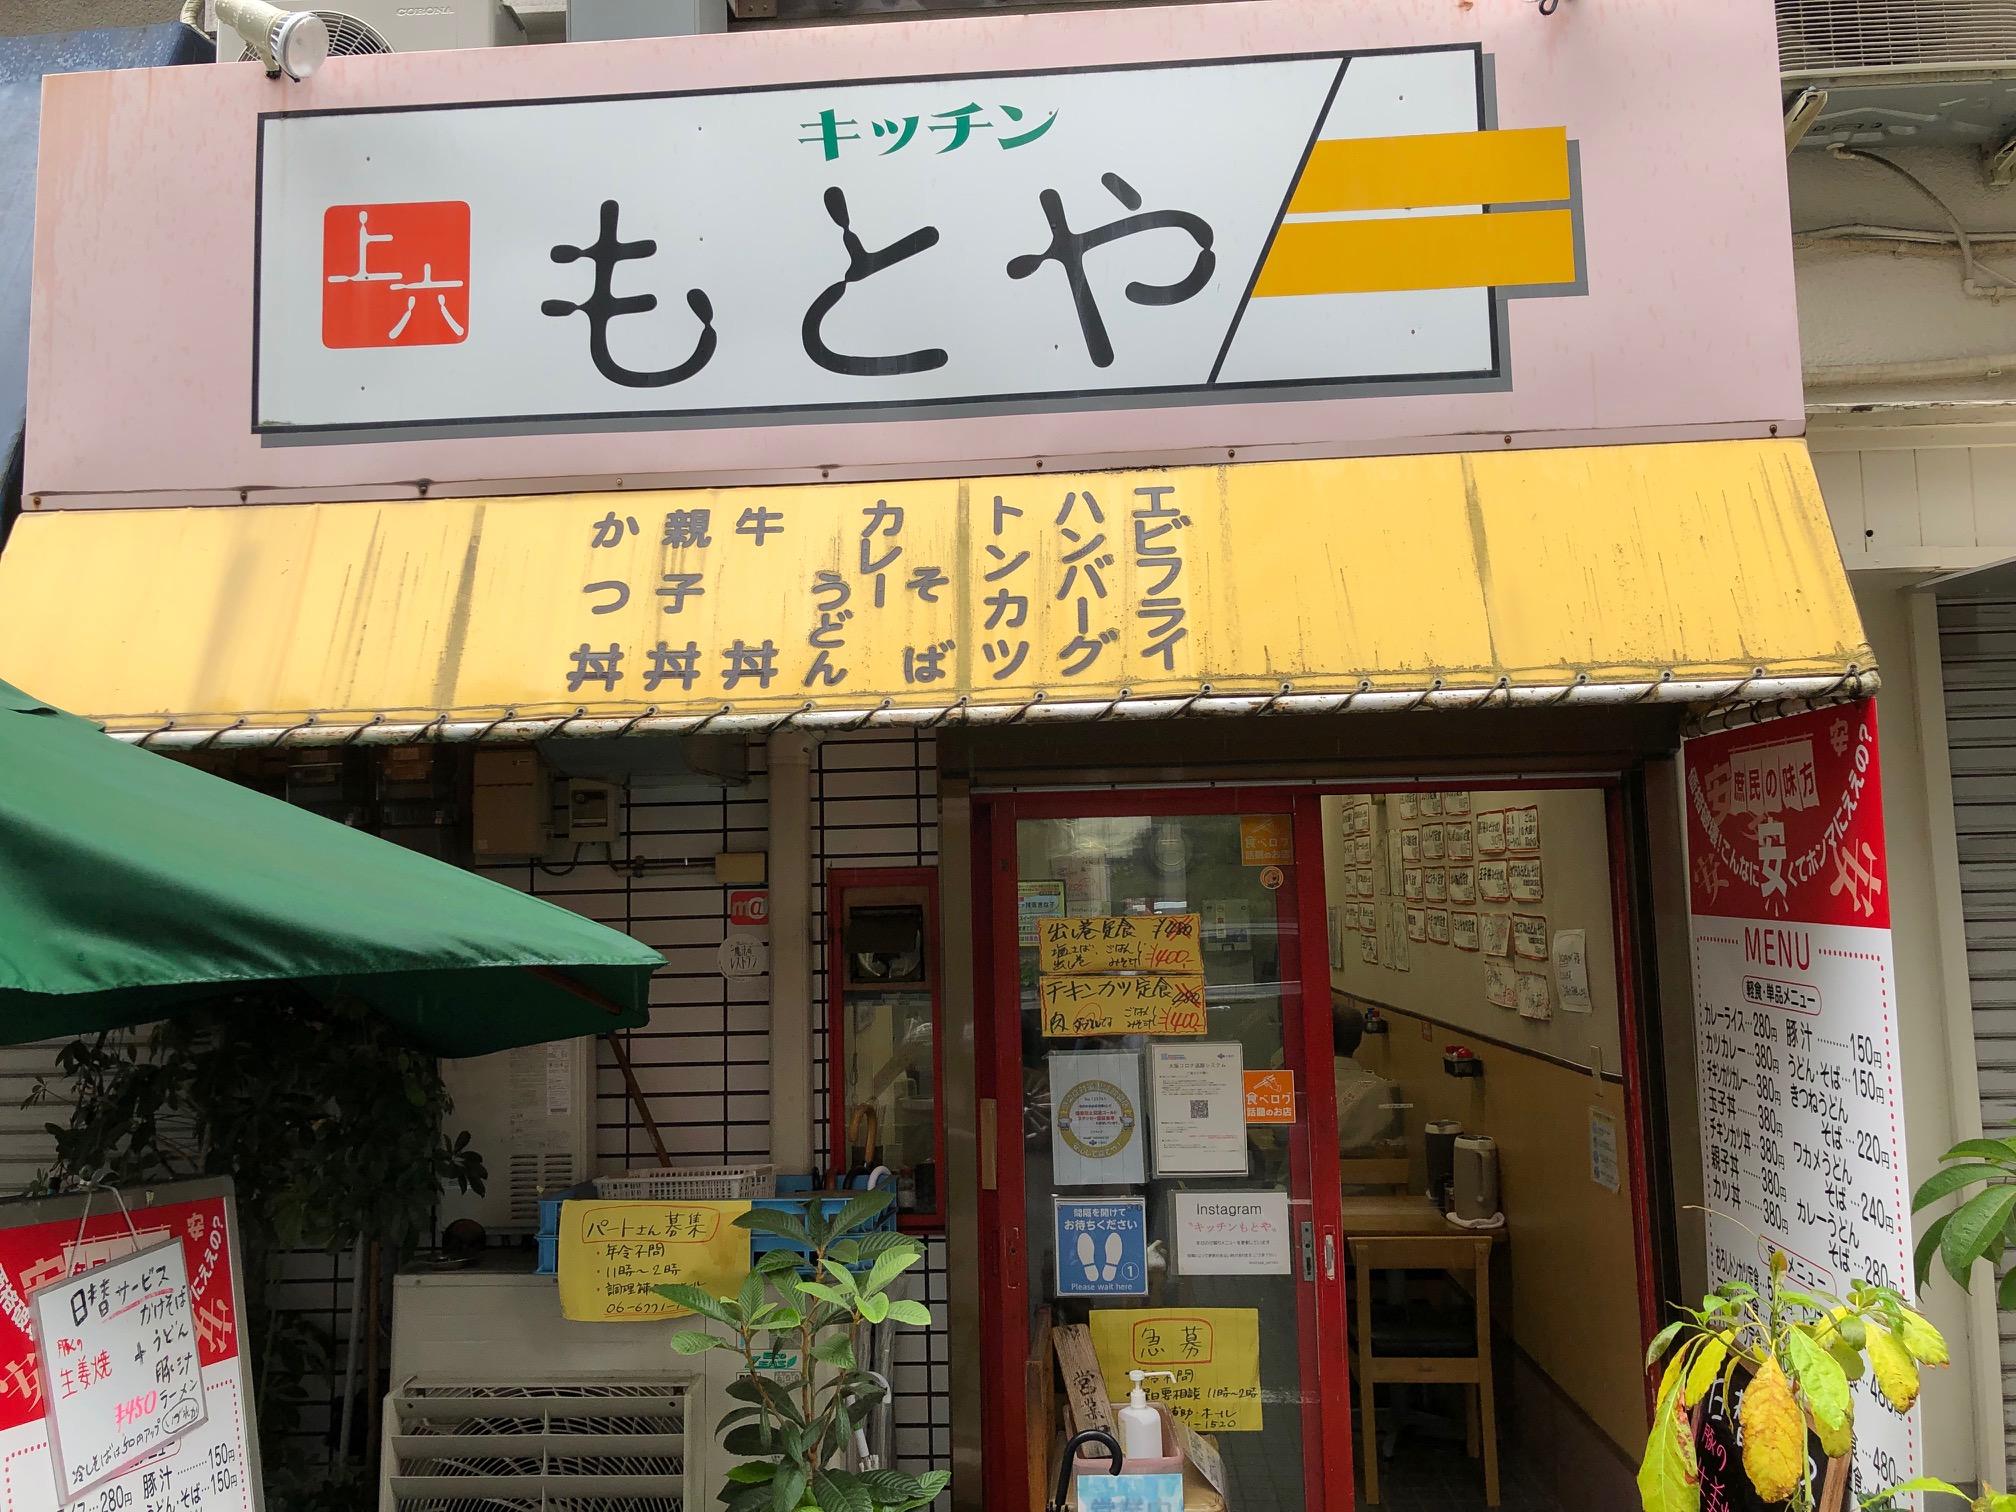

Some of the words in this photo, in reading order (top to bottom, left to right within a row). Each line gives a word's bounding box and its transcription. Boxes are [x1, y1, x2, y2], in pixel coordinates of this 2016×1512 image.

[396, 6, 455, 17] CORONA
[797, 102, 1060, 161] キッチン
[327, 210, 465, 340] 上六
[540, 171, 1216, 388] もとや
[861, 499, 903, 608] カレー
[643, 507, 712, 690] 親子丼
[722, 506, 784, 689] 牛丼
[983, 495, 1031, 680] トンカツ
[1054, 490, 1120, 676] ハンバーグ
[1133, 485, 1190, 671] エビフライ
[566, 511, 640, 692] かつ丼
[804, 571, 854, 686] うどん
[904, 566, 955, 682] そば
[1734, 761, 1816, 802] 庶民の味方
[1745, 926, 1810, 971] MENU
[1046, 977, 1174, 1004] チキンカツ定食
[1746, 980, 1817, 1007] 軽食・単品メニュー
[1704, 1002, 1746, 1034] カレーライス
[1753, 1012, 1778, 1043] 280円
[1786, 1018, 1813, 1052] 豚汁
[1850, 1032, 1882, 1069] 150円
[1706, 1030, 1746, 1060] カツカレー
[1754, 1042, 1780, 1074] 380円
[1246, 1091, 1291, 1105] 食べログ
[1756, 1073, 1782, 1106] 380円
[1790, 1083, 1849, 1124] きつねうどん
[1852, 1067, 1885, 1105] 150円
[1246, 1107, 1292, 1117] 話題のお店
[1708, 1086, 1737, 1120] 玉子丼
[1758, 1104, 1784, 1138] 380円
[1759, 1135, 1785, 1170] 380円
[1793, 1141, 1853, 1186] ワカメうどん
[1821, 1119, 1844, 1150] そば
[1857, 1129, 1890, 1169] 220円
[1711, 1143, 1740, 1181] 親子丼
[1761, 1166, 1787, 1203] 380円
[587, 1211, 706, 1238] パートさん募集
[1064, 1219, 1137, 1231] お待ちください
[1074, 1208, 1127, 1218] 間隔を開けて
[1197, 1203, 1262, 1216] Instagram
[1713, 1174, 1741, 1211] カツ丼
[1763, 1198, 1789, 1235] 380円
[1797, 1198, 1860, 1249] カレーうどん
[1825, 1180, 1847, 1211] そば
[1861, 1192, 1894, 1234] 240円
[605, 1243, 665, 1260] 年令不問
[1828, 1239, 1851, 1273] そば
[70, 1265, 170, 1327] 日替サービス
[1071, 1283, 1096, 1291] Please
[1097, 1283, 1114, 1291] wait
[1116, 1283, 1133, 1291] here
[153, 1320, 189, 1353] うどん
[1141, 1326, 1203, 1359] 急募
[59, 1348, 113, 1400] 生姜焼
[155, 1351, 193, 1384] 豚汁
[159, 1379, 198, 1409] ラーメン
[143, 1465, 173, 1500] 豚汁
[208, 1442, 236, 1471] 150円
[210, 1467, 238, 1496] 150円
[100, 1485, 133, 1511] 280円
